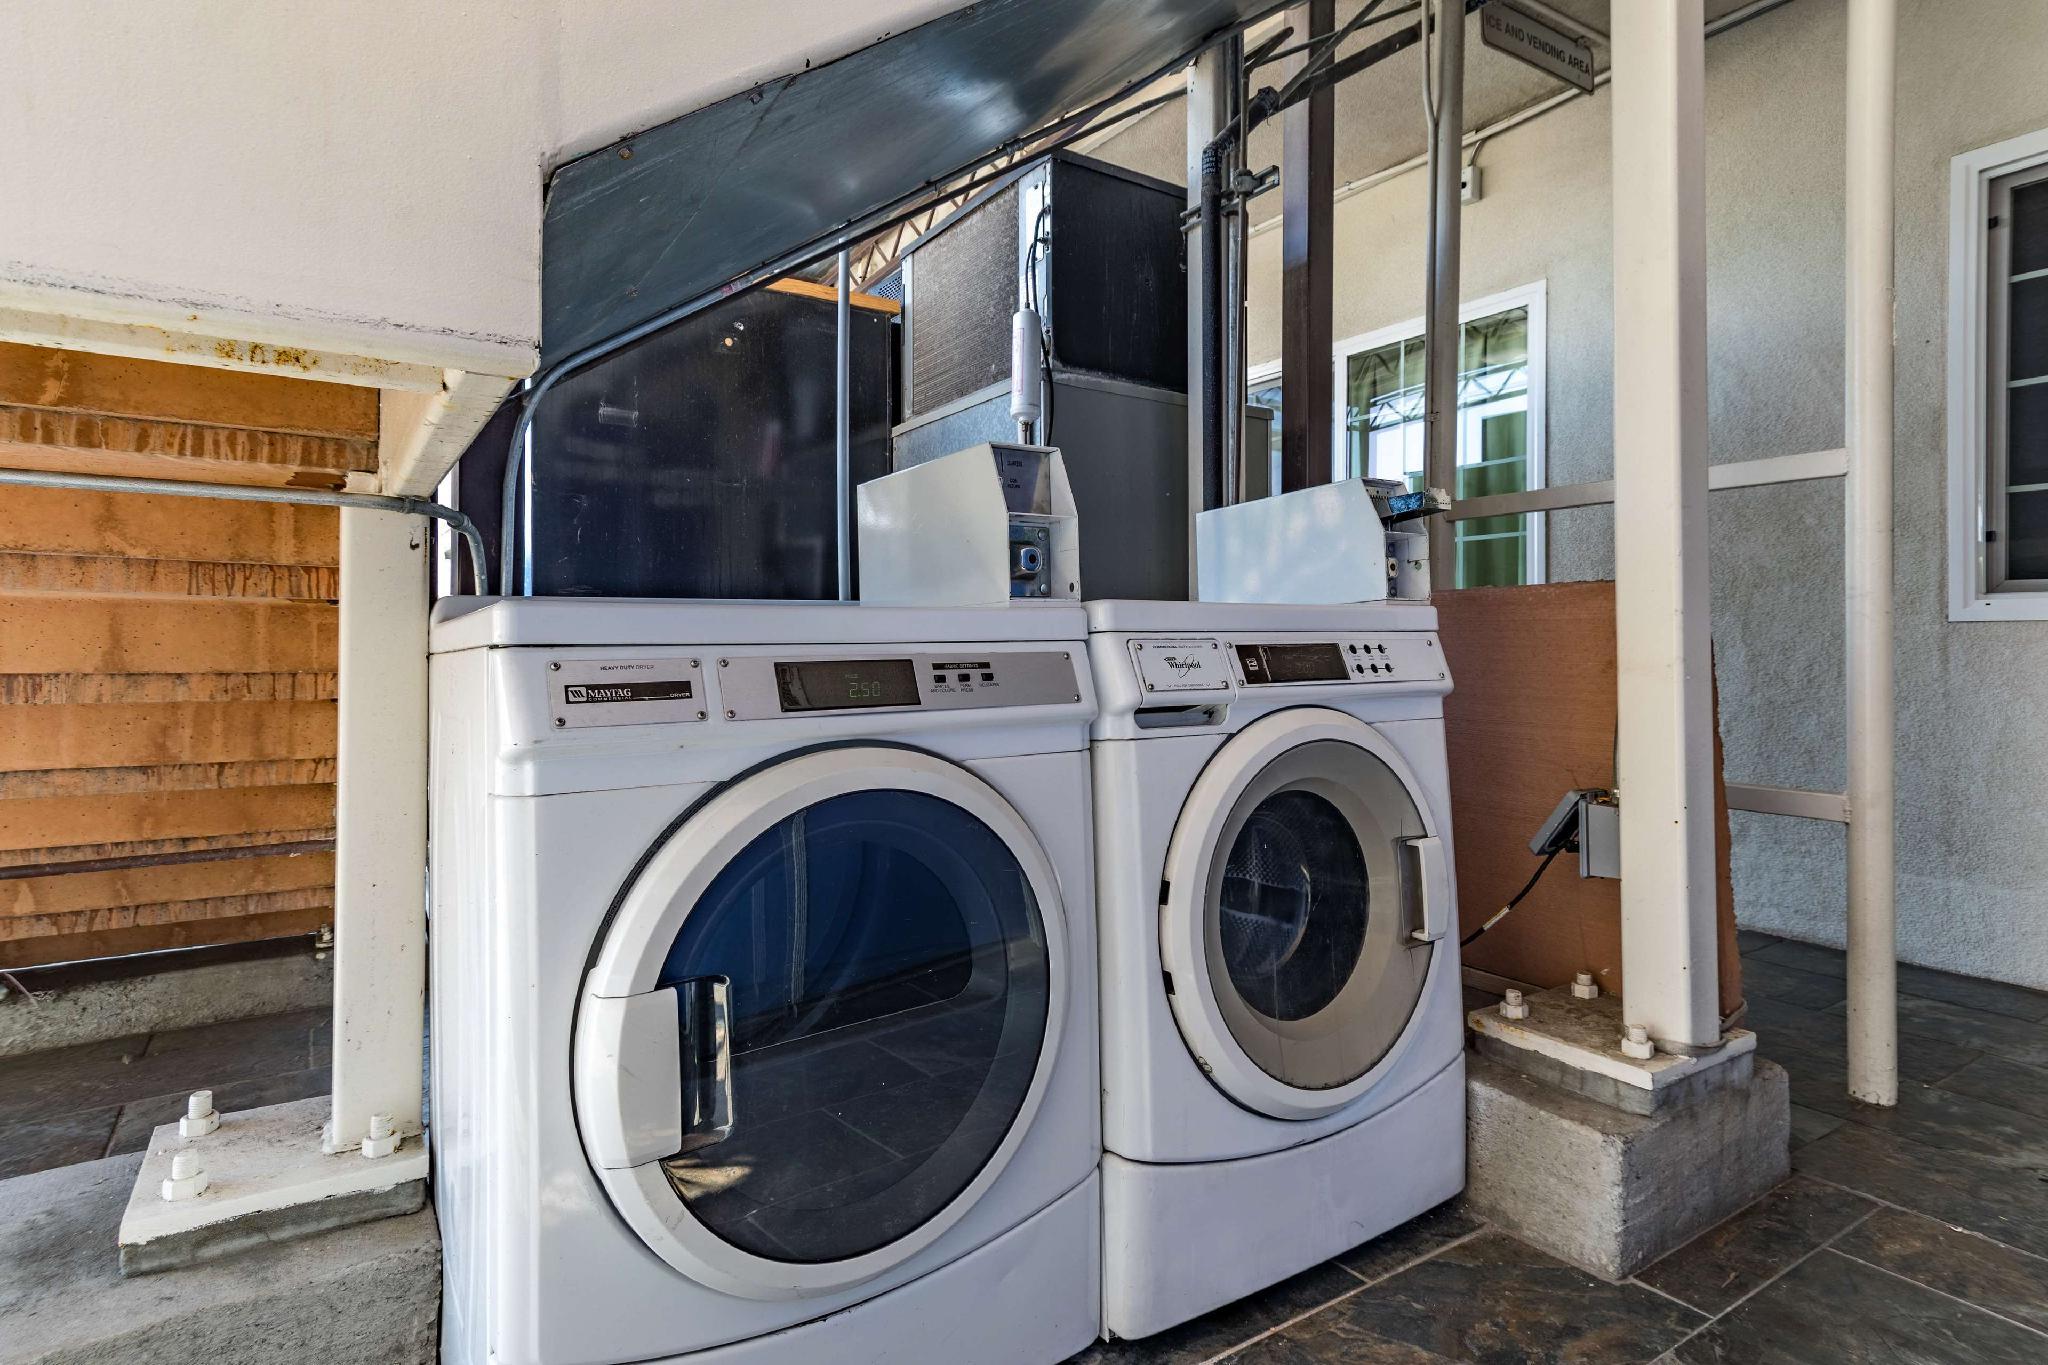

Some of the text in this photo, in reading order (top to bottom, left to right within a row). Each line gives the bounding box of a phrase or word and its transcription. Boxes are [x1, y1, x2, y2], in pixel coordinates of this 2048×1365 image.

[1485, 14, 1590, 76] ICE AND VENDING AREA
[588, 688, 631, 698] MAYTAG
